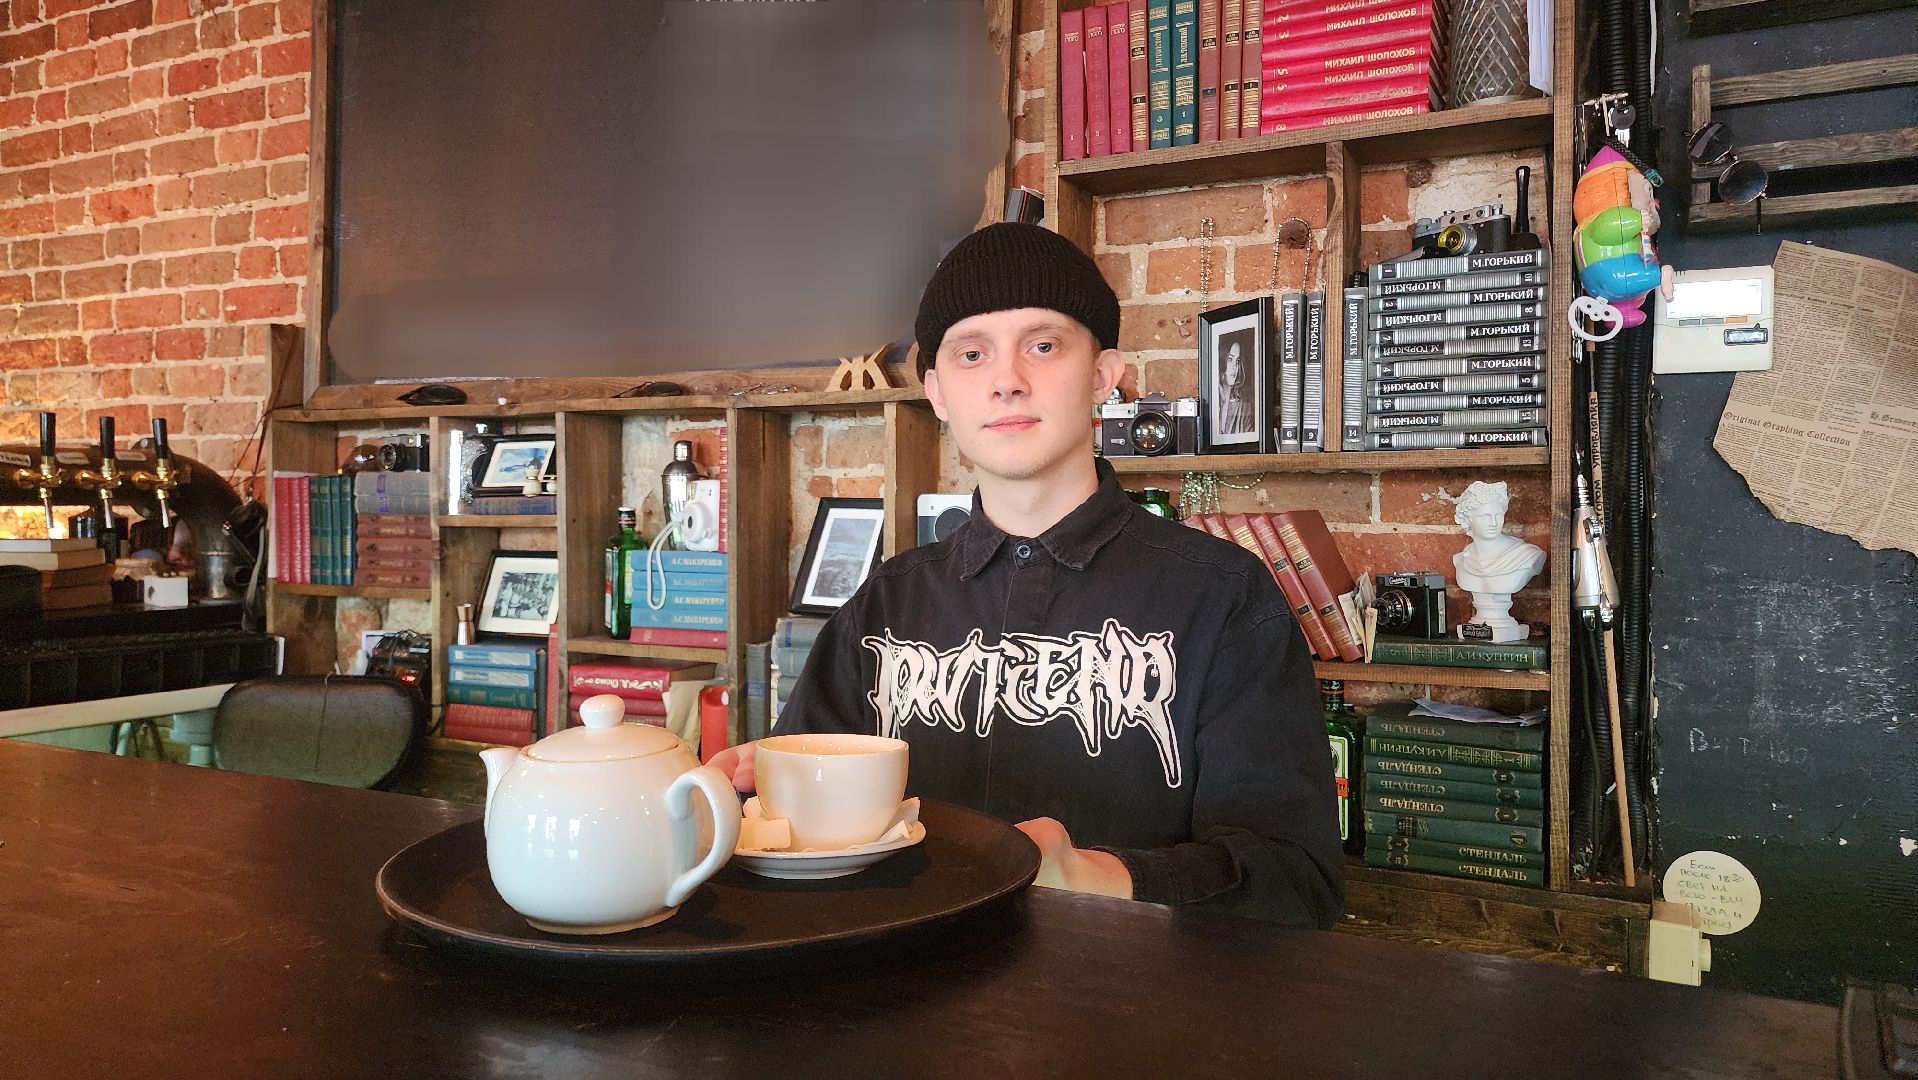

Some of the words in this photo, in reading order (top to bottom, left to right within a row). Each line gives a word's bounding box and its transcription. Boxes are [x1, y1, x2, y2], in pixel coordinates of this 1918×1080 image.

[1326, 17, 1366, 31] МИХАИЛ
[1369, 8, 1417, 23] ШОЛОХОВ
[1325, 55, 1364, 69] МИХАИЛ
[1368, 46, 1416, 62] ШОЛОХОВ
[1278, 68, 1289, 76] 5
[1324, 70, 1364, 84] МИХАИЛ
[1367, 62, 1415, 78] ШОЛОХОВ
[1322, 113, 1362, 126] МИХАИЛ
[1366, 106, 1414, 120] ШОЛОХОВ
[1472, 253, 1533, 268] М.ГОРЬКИЙ
[1524, 273, 1533, 282] 10
[1384, 281, 1441, 295] М.ГОРЬКИЙ
[1473, 288, 1534, 303] М.ГОРЬКИЙ
[1385, 312, 1442, 327] М.ГОРЬКИЙ
[1284, 307, 1295, 360] М.ГОРЬКИЙ
[1309, 307, 1320, 360] М.ГОРЬКИЙ
[1350, 302, 1359, 356] М.ГОРЬКИЙ
[1470, 322, 1531, 337] М.ГОРЬКИЙ
[1471, 356, 1532, 369] М.ГОРЬКИЙ
[1382, 381, 1440, 393] М.ГОРЬКИЙ
[1472, 393, 1533, 405] М.ГОРЬКИЙ
[1382, 415, 1440, 427] М.ГОРЬКИЙ
[1522, 411, 1532, 420] 15
[1590, 397, 1601, 470] УПРАВЛЯЛКА
[1724, 411, 1761, 427] Original
[1806, 430, 1851, 446] Collection
[1469, 431, 1529, 443] М.ГОРЬКИЙ
[1380, 722, 1446, 737] СТЕНДАЛЬ
[1377, 761, 1442, 775] СТЕНДАЛЬ
[1380, 780, 1446, 794] СТЕНДАЛЬ
[1379, 797, 1445, 812] СТЕНДАЛЬ
[1458, 847, 1527, 864] СТЕНДАЛЬ
[1458, 864, 1528, 881] СТЕНДАЛЬ
